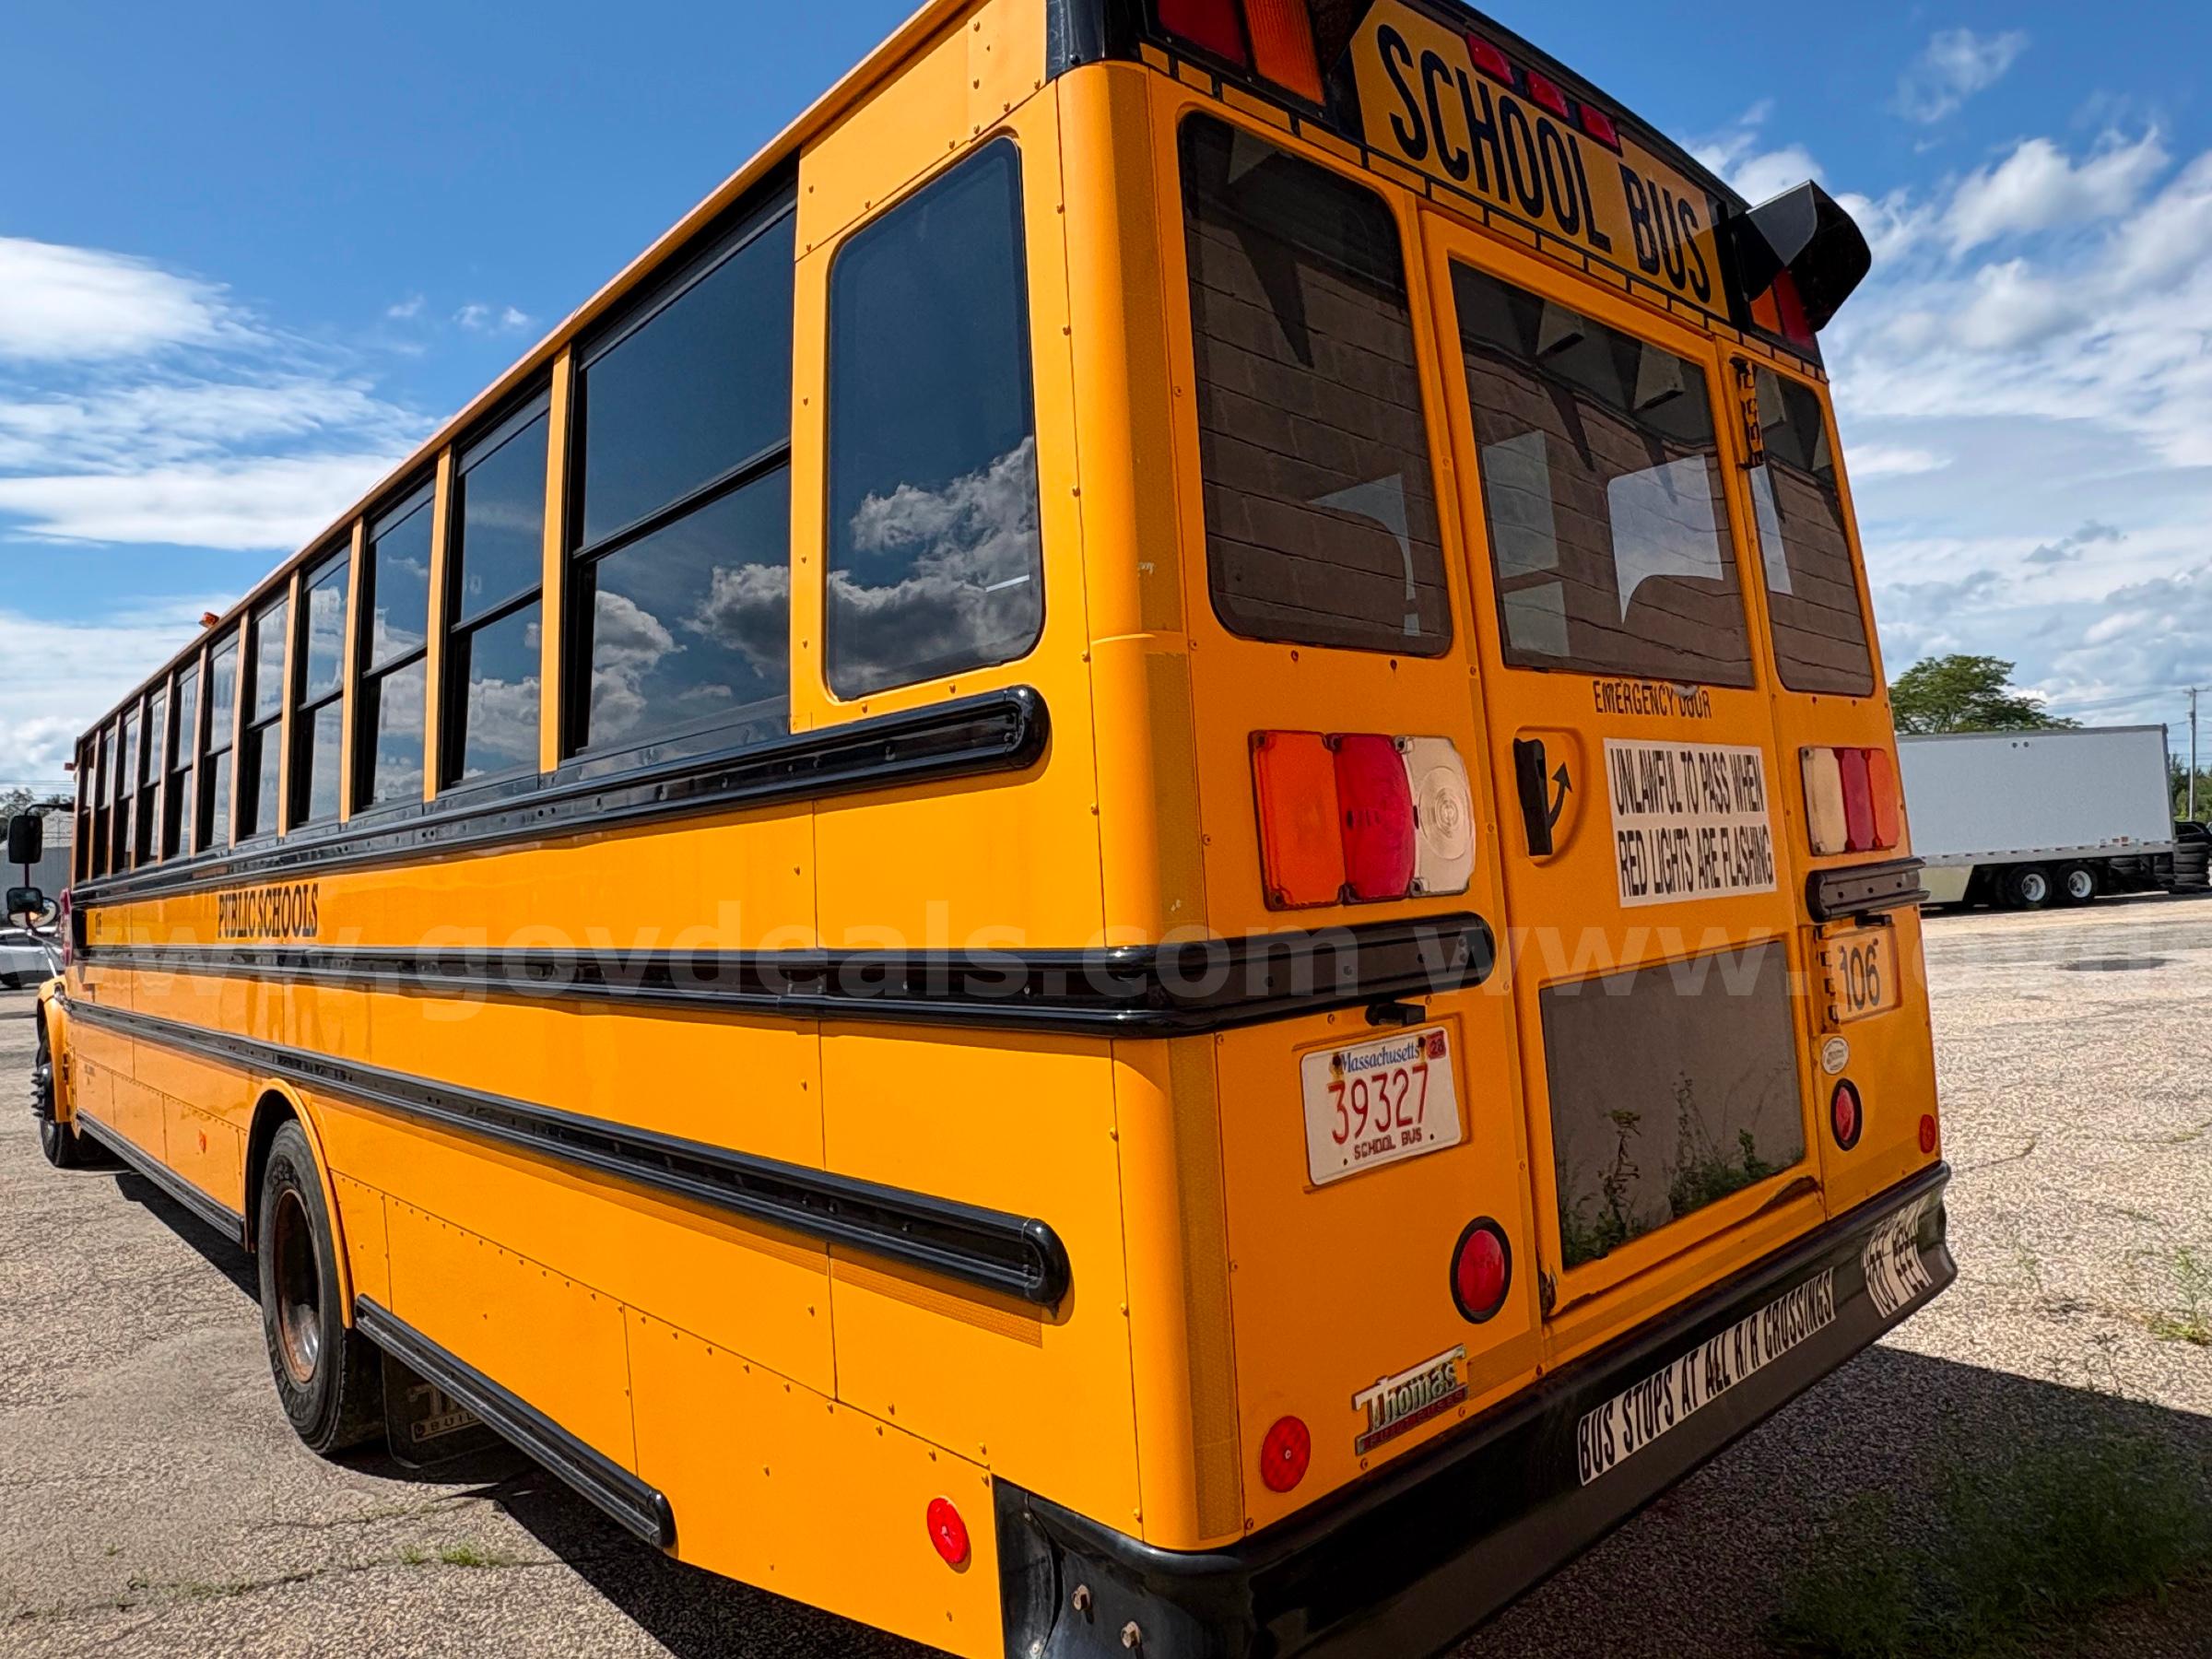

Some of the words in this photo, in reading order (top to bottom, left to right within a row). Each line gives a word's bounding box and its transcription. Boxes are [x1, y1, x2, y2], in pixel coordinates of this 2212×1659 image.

[1377, 24, 1612, 254] SCHOOL
[1618, 162, 1712, 304] BUS
[1593, 680, 1675, 716] EMERGENCY
[1678, 686, 1712, 719] DOOR
[1610, 748, 1683, 816] UNLAWFUL
[1680, 750, 1699, 815] TO
[1699, 751, 1731, 814] PASS
[1729, 754, 1764, 813] WHEN
[1618, 830, 1648, 897] RED
[1649, 827, 1693, 894] LIGHTS
[1697, 828, 1721, 889] ARE
[1720, 824, 1774, 888] FLASHING
[218, 890, 256, 938] PUBLIC
[257, 882, 318, 938] SCHOOLS
[1841, 945, 1880, 1013] 106
[1340, 1041, 1420, 1074] Massachusetts
[1328, 1063, 1428, 1145] 39327
[1354, 1135, 1395, 1160] SCHOOL
[1402, 1127, 1422, 1147] BUS
[1893, 1238, 1932, 1299] FEET
[1353, 1343, 1465, 1430] Thomas
[1579, 1399, 1616, 1481] BUS
[1622, 1363, 1675, 1453] STOPS
[1681, 1348, 1700, 1416] AT
[1705, 1332, 1731, 1399] ALL
[1735, 1314, 1760, 1380] R/R
[1764, 1269, 1833, 1360] CROSSINGS
[430, 1412, 474, 1431] BUIL
